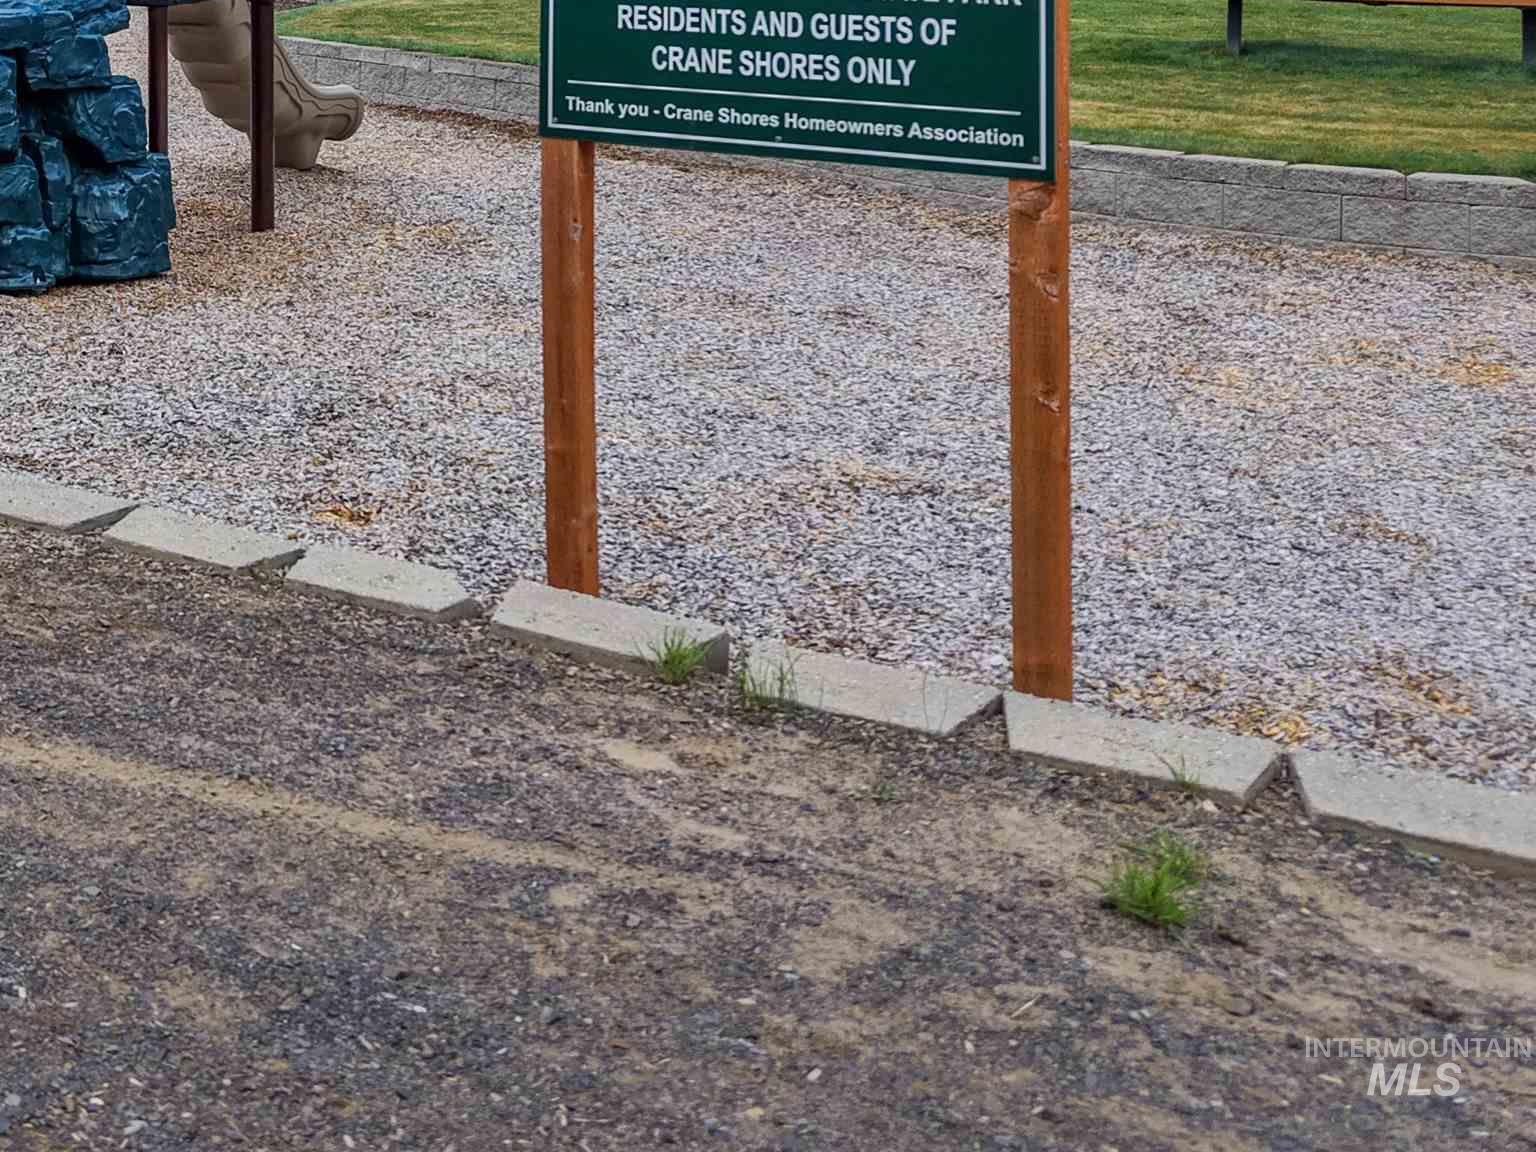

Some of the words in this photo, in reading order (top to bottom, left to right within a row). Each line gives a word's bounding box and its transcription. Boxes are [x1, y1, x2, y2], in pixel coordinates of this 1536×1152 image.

[618, 5, 746, 35] RESIDENTS
[752, 11, 803, 37] AND
[811, 13, 912, 43] GUESTS
[921, 18, 956, 45] OF
[652, 46, 732, 74] CRANE
[739, 50, 840, 81] SHORES
[848, 57, 915, 86] ONLY
[566, 96, 614, 114] Thank
[619, 104, 648, 118] you
[664, 104, 713, 121] Crane
[718, 108, 779, 127] Shores
[785, 113, 903, 137] Homeowners
[908, 123, 1023, 146] Association
